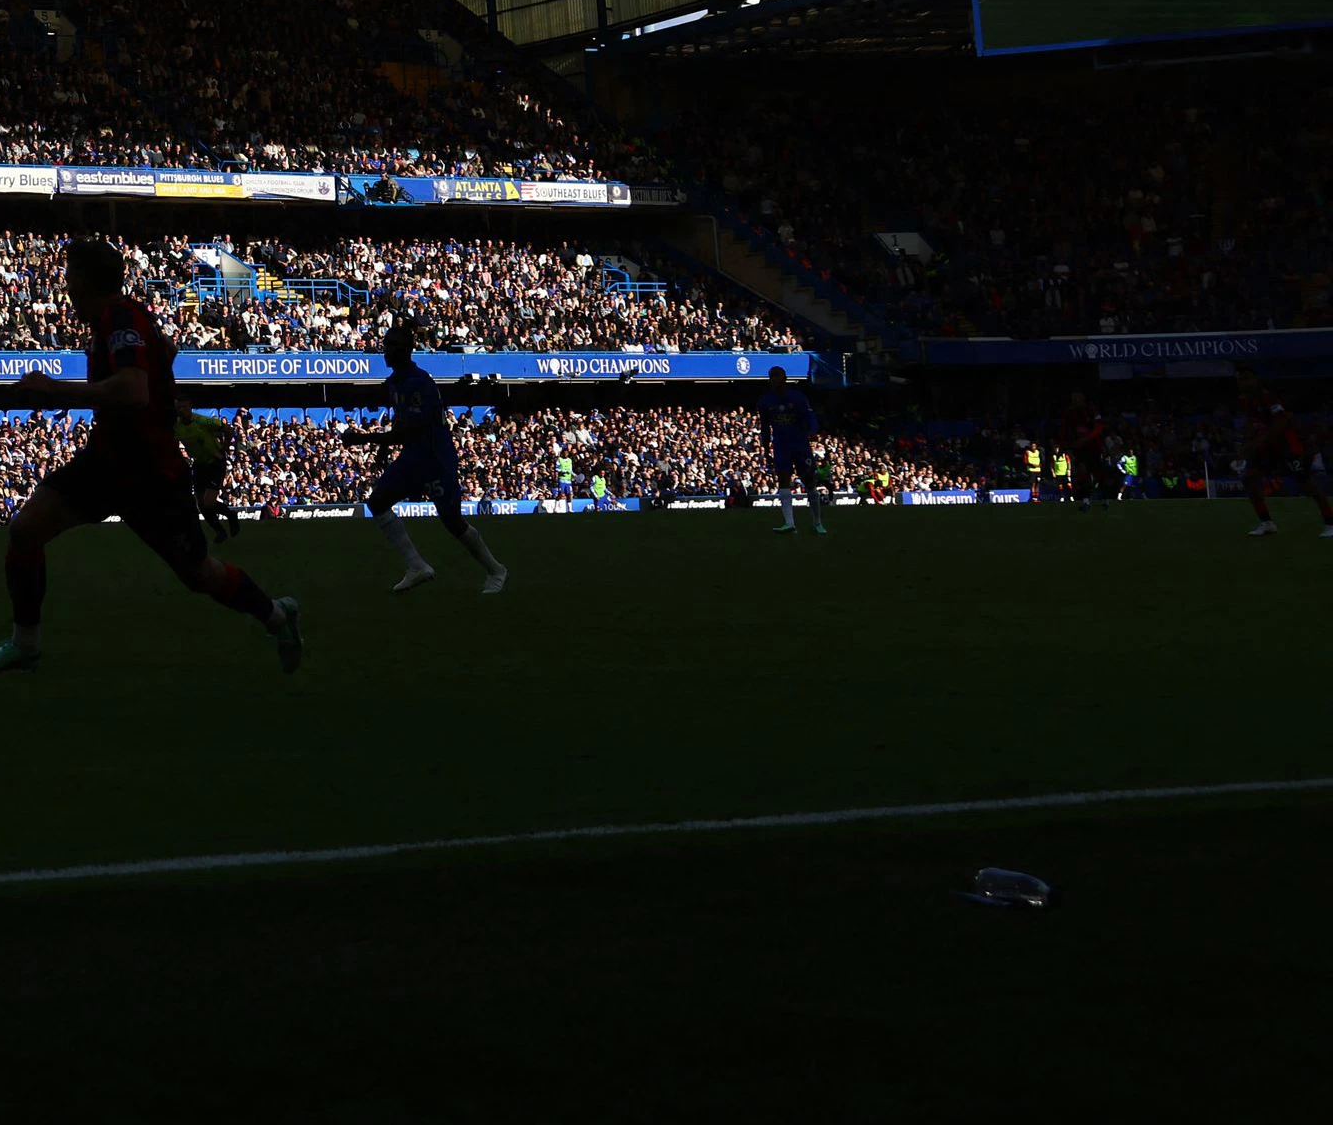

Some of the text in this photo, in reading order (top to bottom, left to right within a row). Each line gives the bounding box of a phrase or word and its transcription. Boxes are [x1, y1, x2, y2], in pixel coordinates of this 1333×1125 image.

[19, 174, 54, 187] Blues
[76, 171, 154, 185] easternblues
[160, 174, 224, 183] PITTSBURGH BLUES
[456, 181, 501, 192] ATLANTA
[583, 188, 606, 199] BLUES
[201, 252, 209, 263] 5
[1068, 338, 1258, 359] WORLD CHAMPIONS
[197, 358, 370, 375] THE PRIDE OF LONDON
[537, 358, 670, 375] WORLD CHAMPIONS
[921, 492, 972, 505] Museum
[289, 507, 355, 519] nike football
[391, 502, 518, 517] EMBER ET MORE
